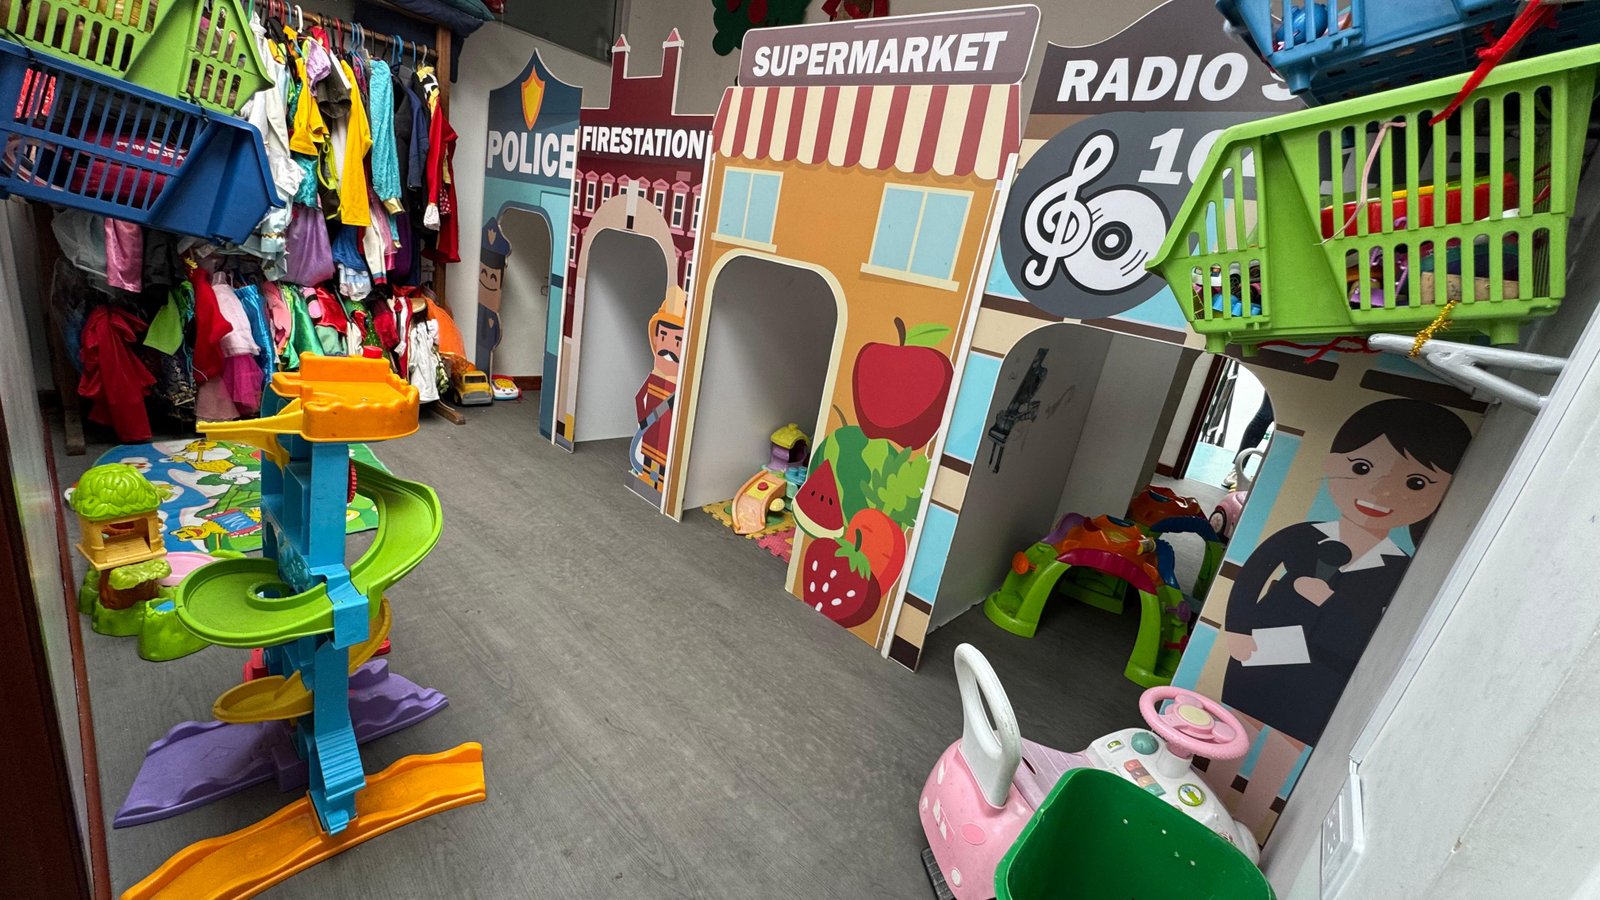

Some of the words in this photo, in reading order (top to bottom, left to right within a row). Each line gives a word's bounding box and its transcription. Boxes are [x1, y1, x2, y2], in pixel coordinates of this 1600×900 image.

[752, 30, 1008, 77] SUPERMARKET
[1056, 52, 1249, 102] RADIO
[487, 130, 576, 180] POLICE
[581, 125, 706, 160] FIRESTATION
